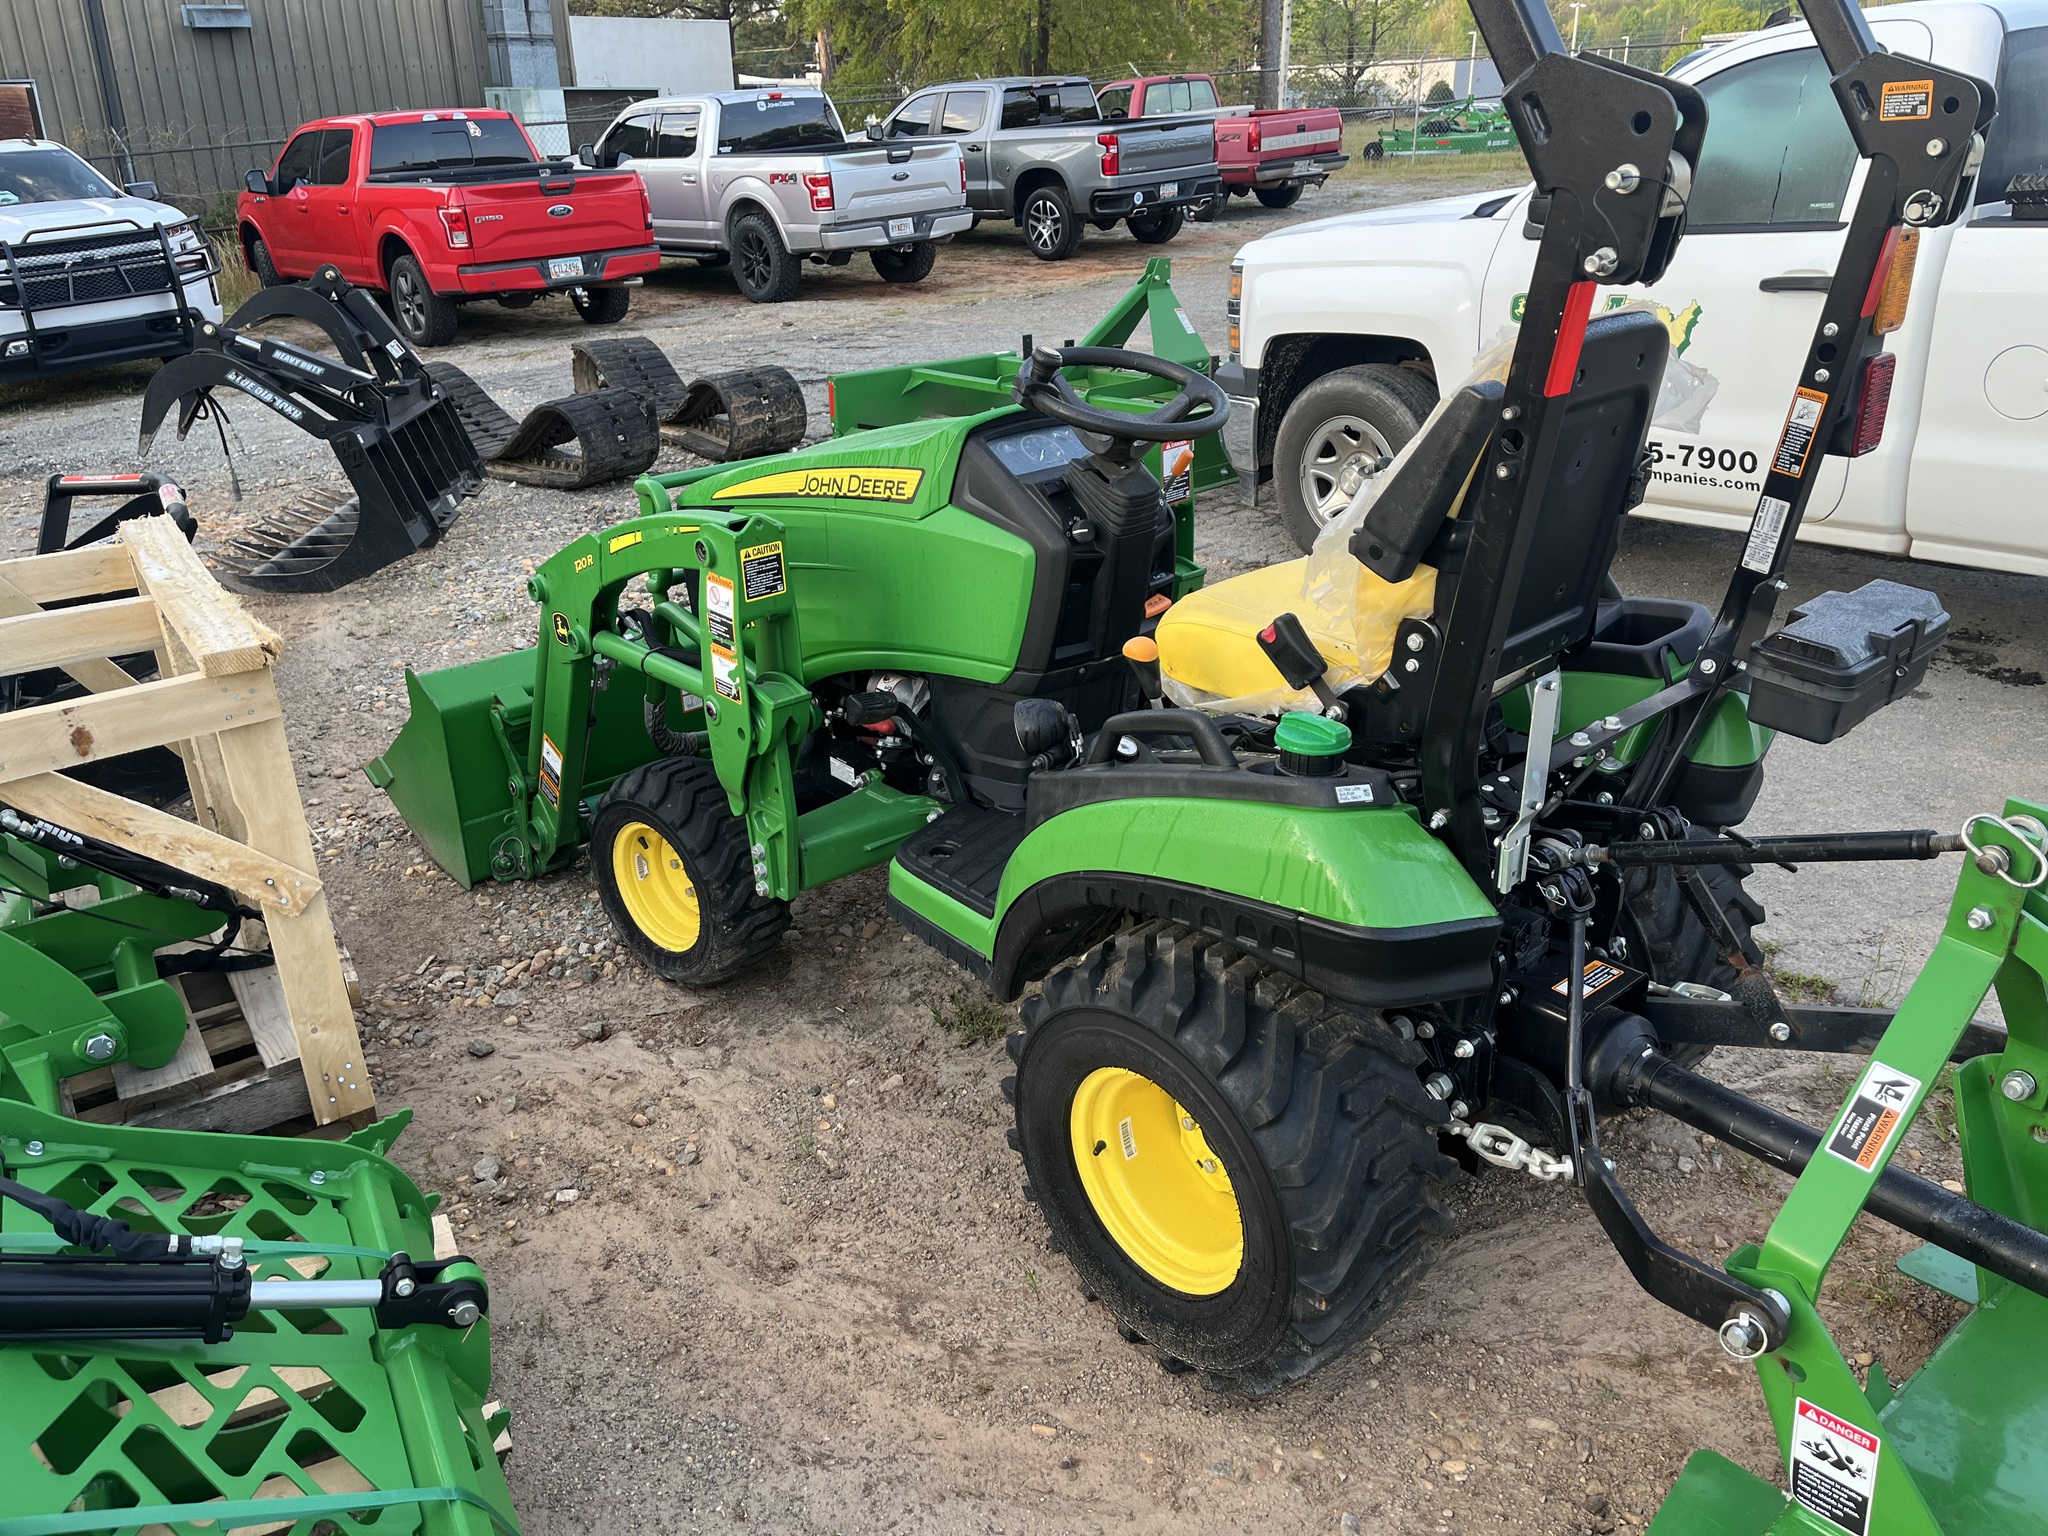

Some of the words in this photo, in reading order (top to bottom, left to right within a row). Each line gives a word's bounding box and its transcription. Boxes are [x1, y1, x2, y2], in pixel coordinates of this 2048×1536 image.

[1127, 135, 1210, 152] CHEVROLET
[1219, 133, 1241, 142] Z71
[1268, 132, 1332, 147] CHEVROLET
[770, 173, 797, 184] FX4
[274, 350, 301, 367] HEAVY
[301, 361, 323, 375] DUTY
[1804, 392, 1824, 401] WARNING
[798, 474, 843, 494] JOHN
[847, 474, 908, 496] DEERE
[752, 543, 780, 556] CAUTION
[1846, 1116, 1864, 1139] Hazard
[1861, 1113, 1876, 1132] Pinch
[1851, 1132, 1866, 1149] Point
[1860, 1120, 1890, 1163] WARNING
[1819, 1415, 1871, 1448] DANGER
